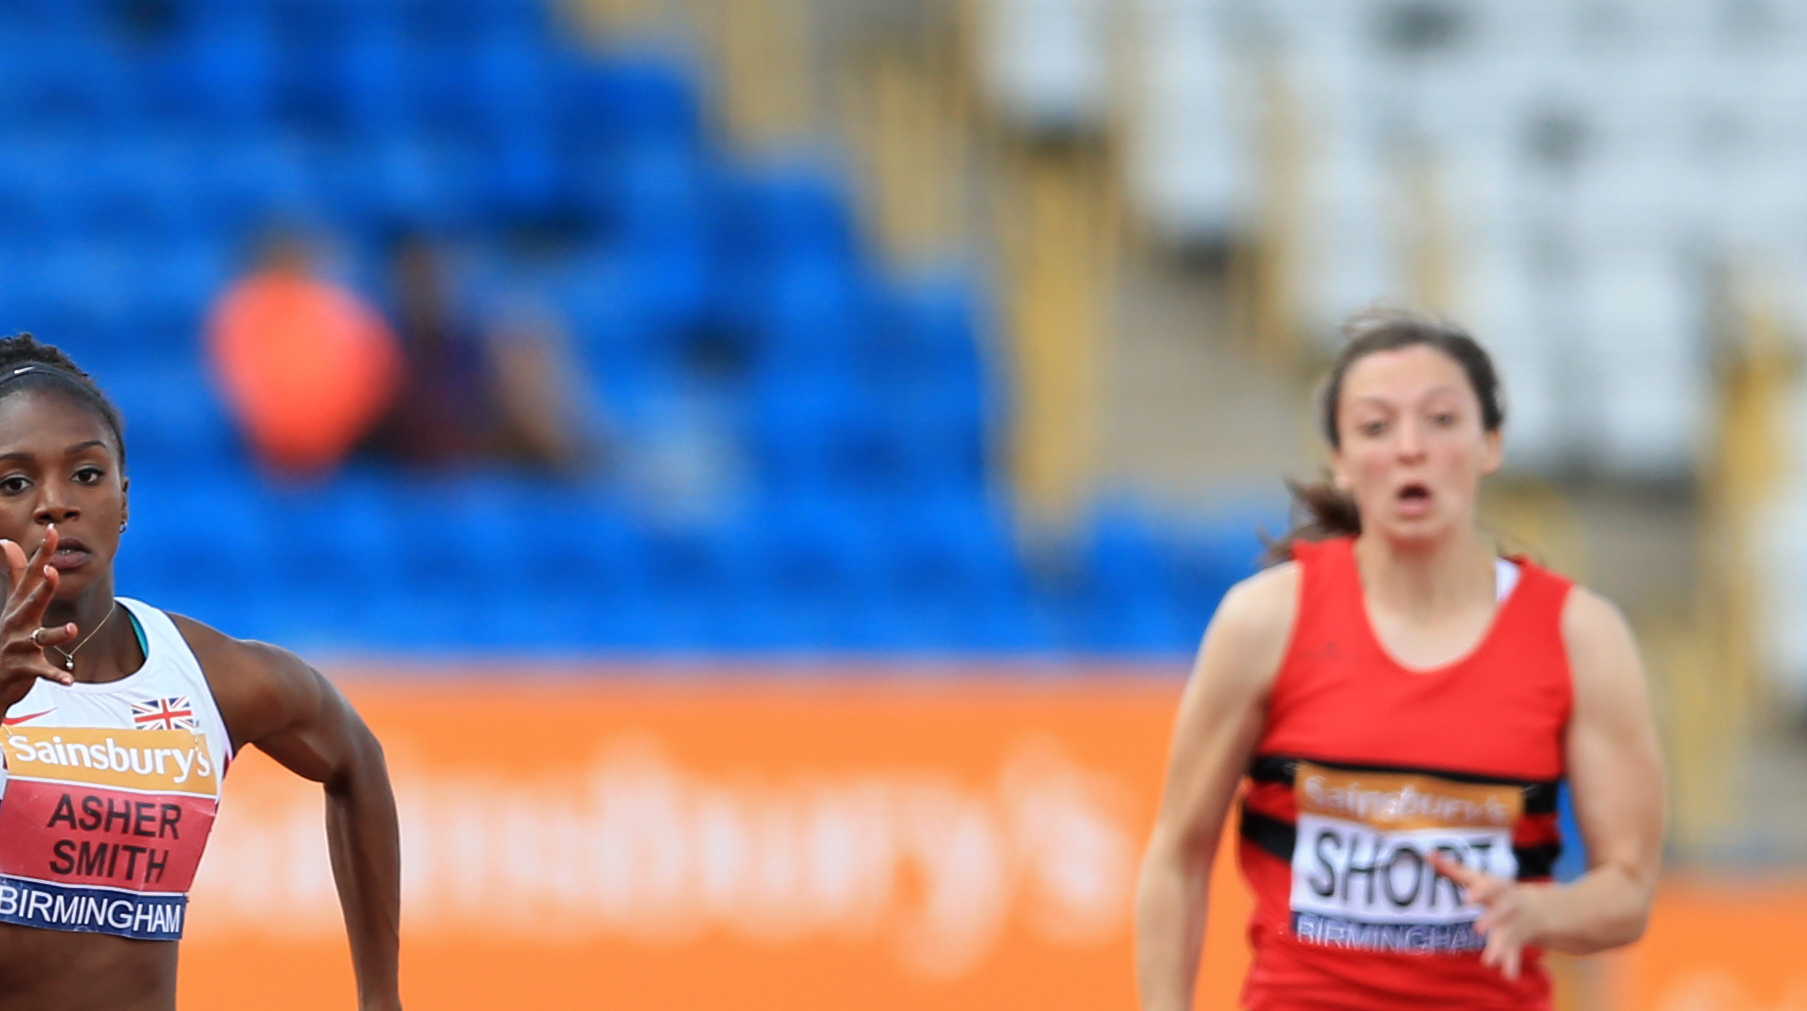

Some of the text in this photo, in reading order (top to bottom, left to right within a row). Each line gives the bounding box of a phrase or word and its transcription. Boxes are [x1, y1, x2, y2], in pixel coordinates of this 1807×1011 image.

[7, 733, 211, 784] Sainsbury's
[47, 794, 182, 839] ASHER
[49, 840, 169, 884] SMITH
